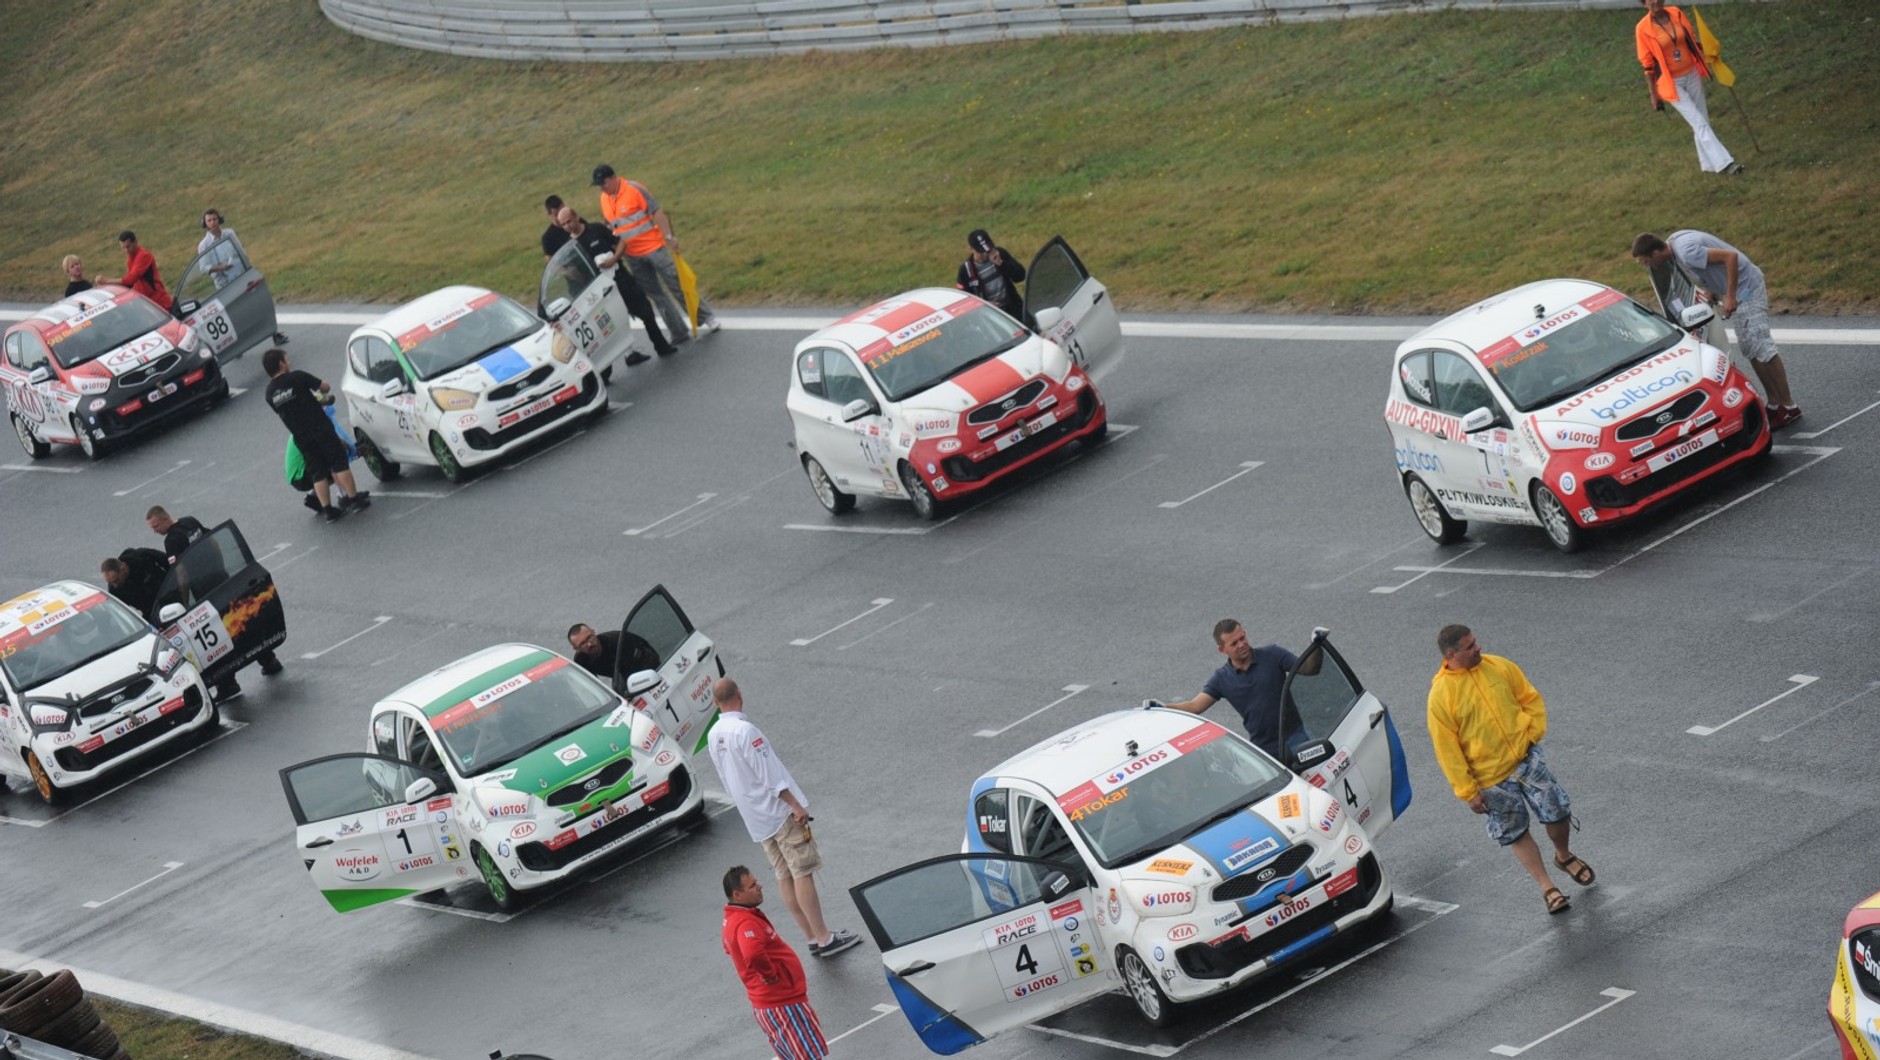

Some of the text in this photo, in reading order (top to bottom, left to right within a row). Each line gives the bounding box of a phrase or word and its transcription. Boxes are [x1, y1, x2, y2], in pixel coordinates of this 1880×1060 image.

[206, 316, 229, 340] 98
[910, 315, 944, 333] LOTOS
[1540, 310, 1579, 331] LOTOS
[575, 321, 595, 349] 26
[115, 340, 155, 361] KIA
[1068, 339, 1085, 366] 11
[1488, 364, 1499, 375] 7
[1716, 354, 1728, 377] LOTOS
[1557, 347, 1693, 417] AUTO-GDYNIA
[1590, 368, 1694, 420] balticon
[531, 400, 551, 413] LOTOS
[925, 420, 951, 430] LOTOS
[1386, 400, 1468, 445] AUTO-GDYNIA
[1568, 431, 1600, 445] LOTOS
[860, 440, 876, 465] 11
[1676, 437, 1704, 459] LOTOS
[1477, 448, 1491, 475] 7
[44, 610, 72, 626] LOTOS
[189, 612, 209, 629] RACE
[194, 623, 218, 651] 15
[212, 644, 228, 659] LOTOS
[490, 679, 523, 696] LOTOS
[653, 681, 670, 700] RACE
[43, 714, 65, 723] LOTOS
[666, 698, 680, 722] 1
[649, 724, 661, 743] LOTOS
[1124, 750, 1168, 775] LOTOS
[1300, 746, 1323, 761] Dynamic
[1332, 757, 1350, 778] RACE
[1343, 778, 1358, 808] 4
[386, 805, 417, 818] KIA LOTOS
[499, 804, 526, 815] LOTOS
[1325, 799, 1341, 822] LOTOS
[387, 813, 416, 826] RACE
[987, 814, 1007, 832] Tokar
[515, 825, 533, 836] KIA
[396, 828, 412, 854] 1
[336, 855, 379, 869] Wafelek
[411, 857, 433, 869] LOTOS
[1315, 860, 1337, 875] Dynamic
[1157, 892, 1191, 904] LOTOS
[1214, 910, 1239, 927] Dynamic
[1279, 897, 1310, 921] LOTOS
[994, 915, 1037, 936] KIA LOTOS
[998, 924, 1037, 945] RACE
[1172, 927, 1194, 939] KIA
[1015, 944, 1038, 975] 4
[1028, 975, 1059, 993] LOTOS
